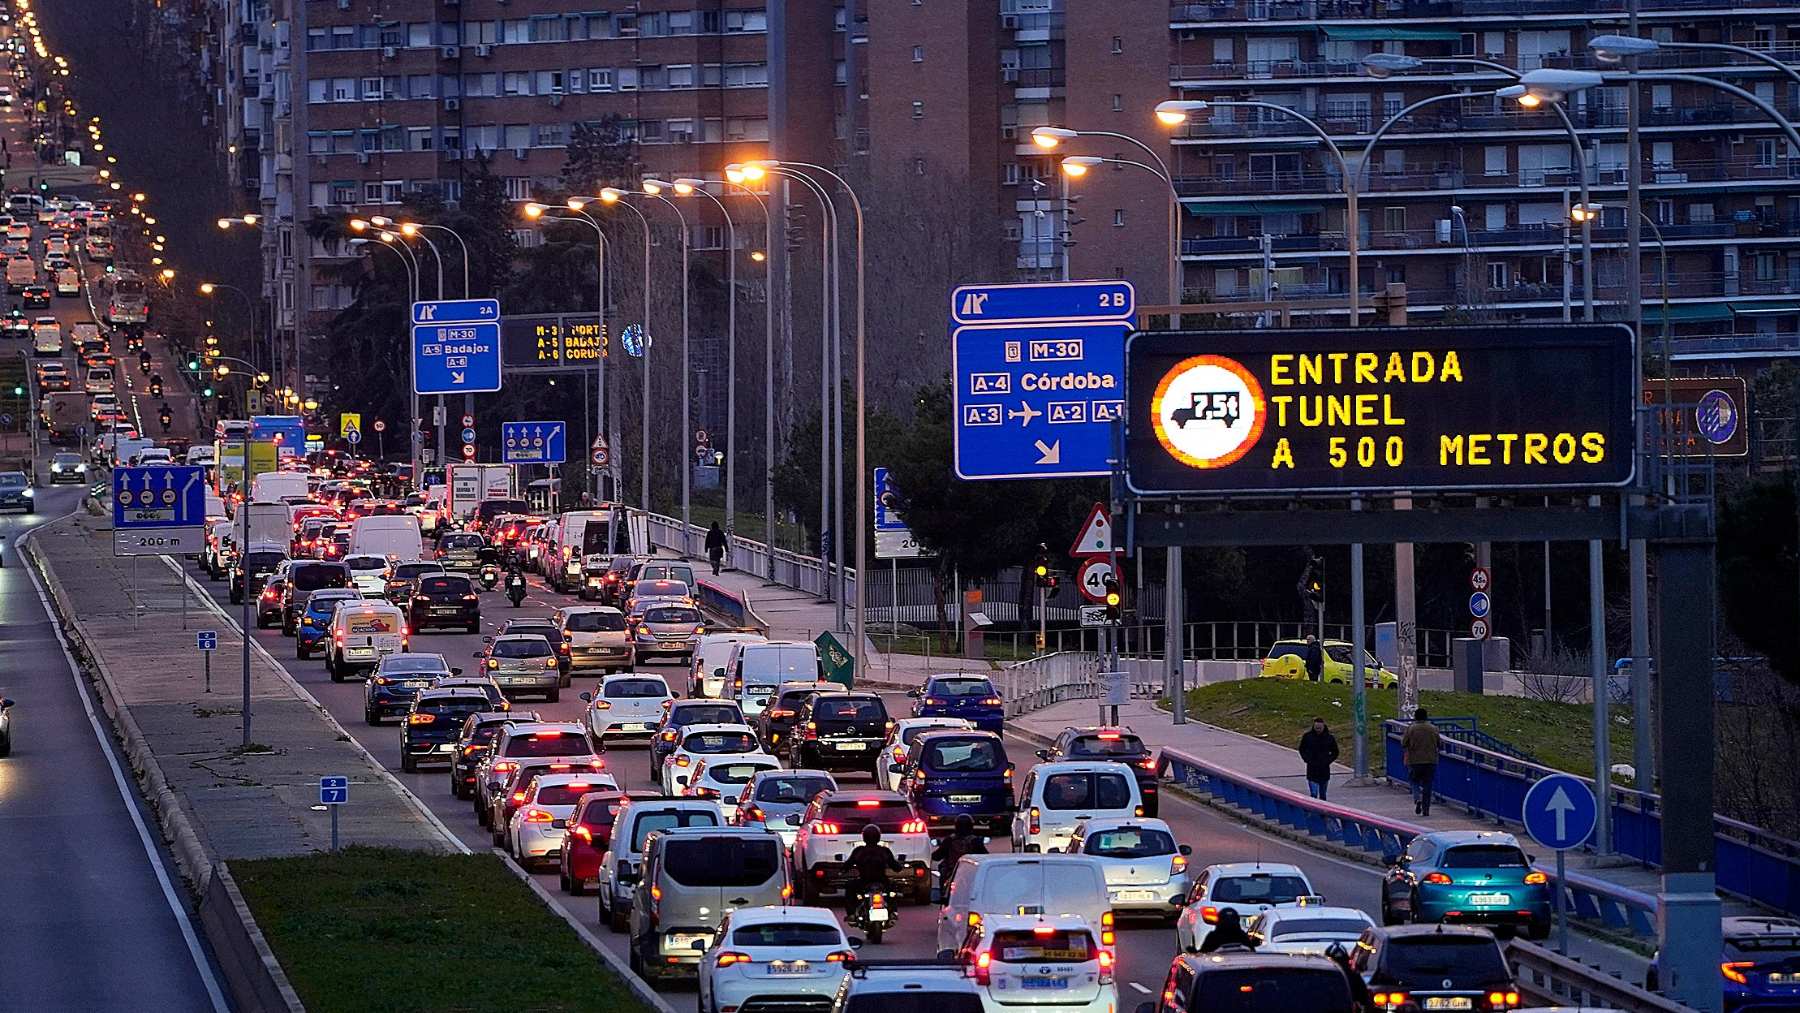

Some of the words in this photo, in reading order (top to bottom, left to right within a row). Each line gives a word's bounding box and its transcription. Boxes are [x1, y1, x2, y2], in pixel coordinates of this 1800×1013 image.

[480, 306, 493, 314] 2A
[450, 330, 474, 338] M-30
[537, 337, 558, 348] A-5
[425, 346, 440, 354] A-5
[444, 343, 489, 354] Badajoz
[1032, 342, 1080, 358] M-30
[538, 350, 559, 360] A-6
[449, 358, 465, 366] A-6
[1270, 350, 1464, 386] ENTRADA
[975, 378, 1007, 391] A-4
[1020, 372, 1115, 391] Córdoba
[968, 409, 999, 423] A-3
[1051, 405, 1083, 420] A-2
[1096, 404, 1123, 419] A-1
[1271, 393, 1406, 428] TUNEL
[1271, 436, 1295, 470] A
[1328, 435, 1405, 469] 500
[1439, 431, 1606, 467] METROS
[139, 537, 164, 546] 200
[170, 538, 180, 546] m
[1473, 626, 1485, 635] 70
[330, 779, 337, 787] 2
[330, 790, 339, 801] 7
